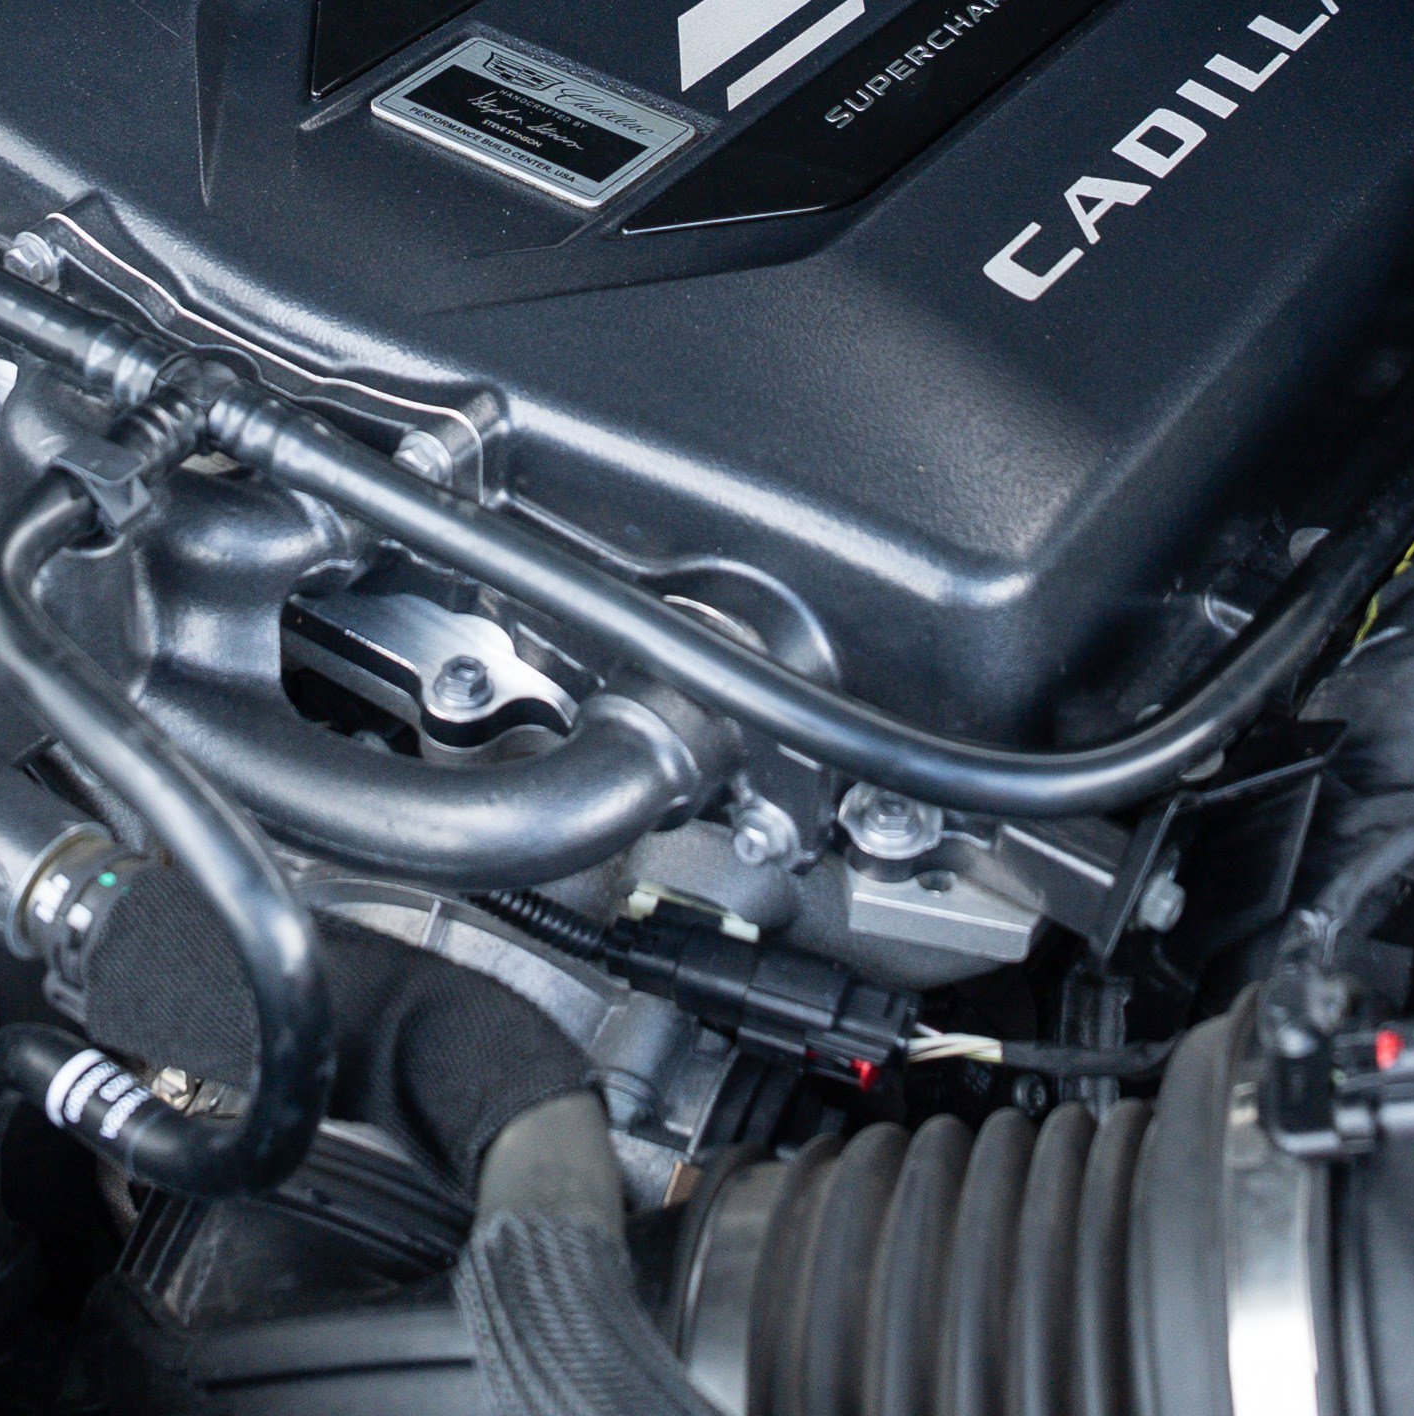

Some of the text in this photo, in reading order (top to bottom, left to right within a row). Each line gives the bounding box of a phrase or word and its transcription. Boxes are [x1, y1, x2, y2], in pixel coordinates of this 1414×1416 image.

[499, 89, 588, 130] HANDCRAFTED BY
[554, 87, 654, 135] Cadillac
[409, 106, 481, 143] PERFORMANCE
[481, 136, 511, 157] BUILD
[554, 168, 577, 184] USA
[481, 118, 543, 149] STEVE STINSON
